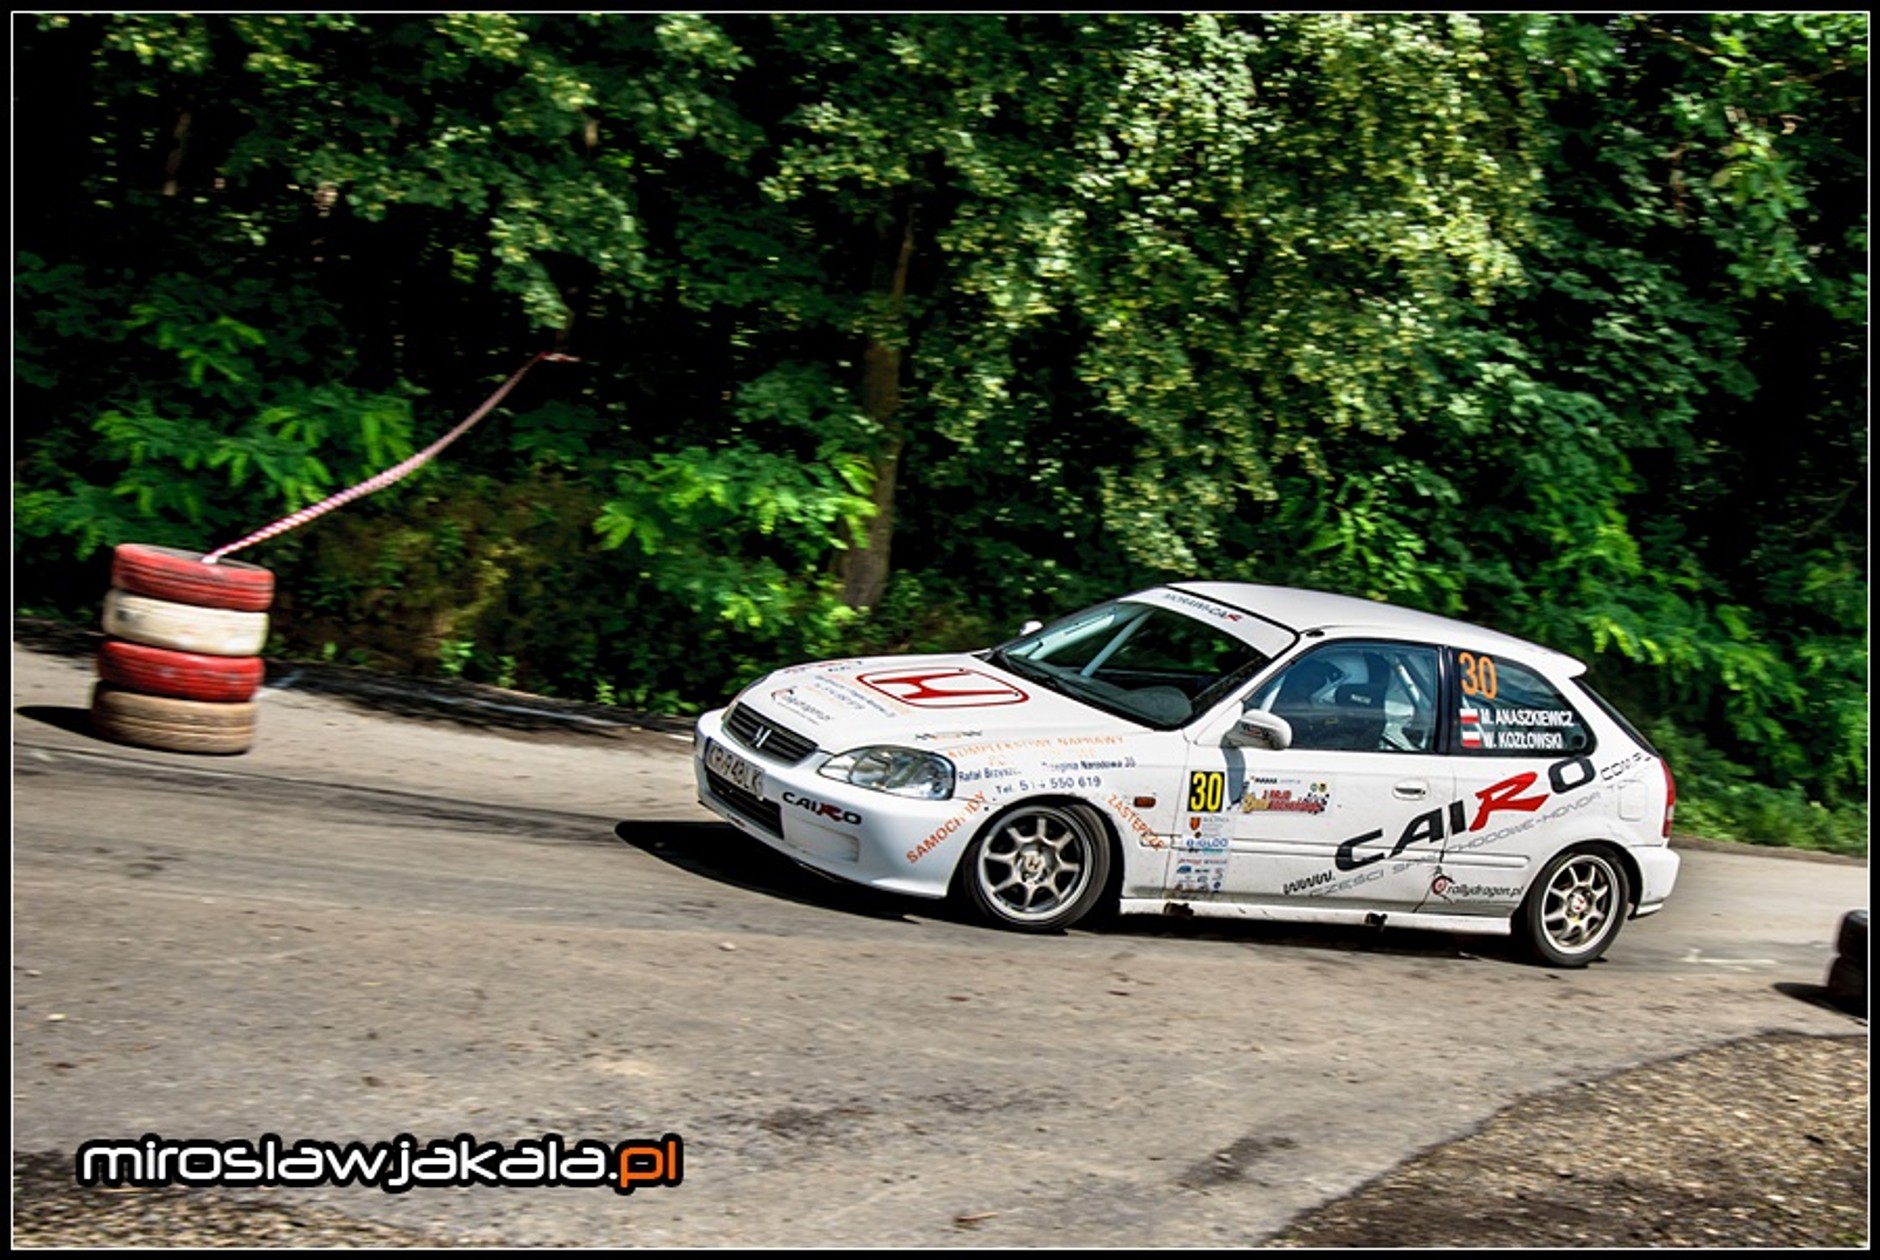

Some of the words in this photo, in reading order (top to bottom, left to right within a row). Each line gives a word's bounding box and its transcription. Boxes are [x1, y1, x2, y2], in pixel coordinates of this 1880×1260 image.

[1458, 652, 1497, 699] 30
[1480, 708, 1494, 724] M.
[1050, 777, 1075, 789] 550
[1078, 775, 1102, 788] 619
[1189, 772, 1224, 811] 30
[782, 791, 862, 825] CAIRO
[1335, 755, 1596, 872] CAIRO
